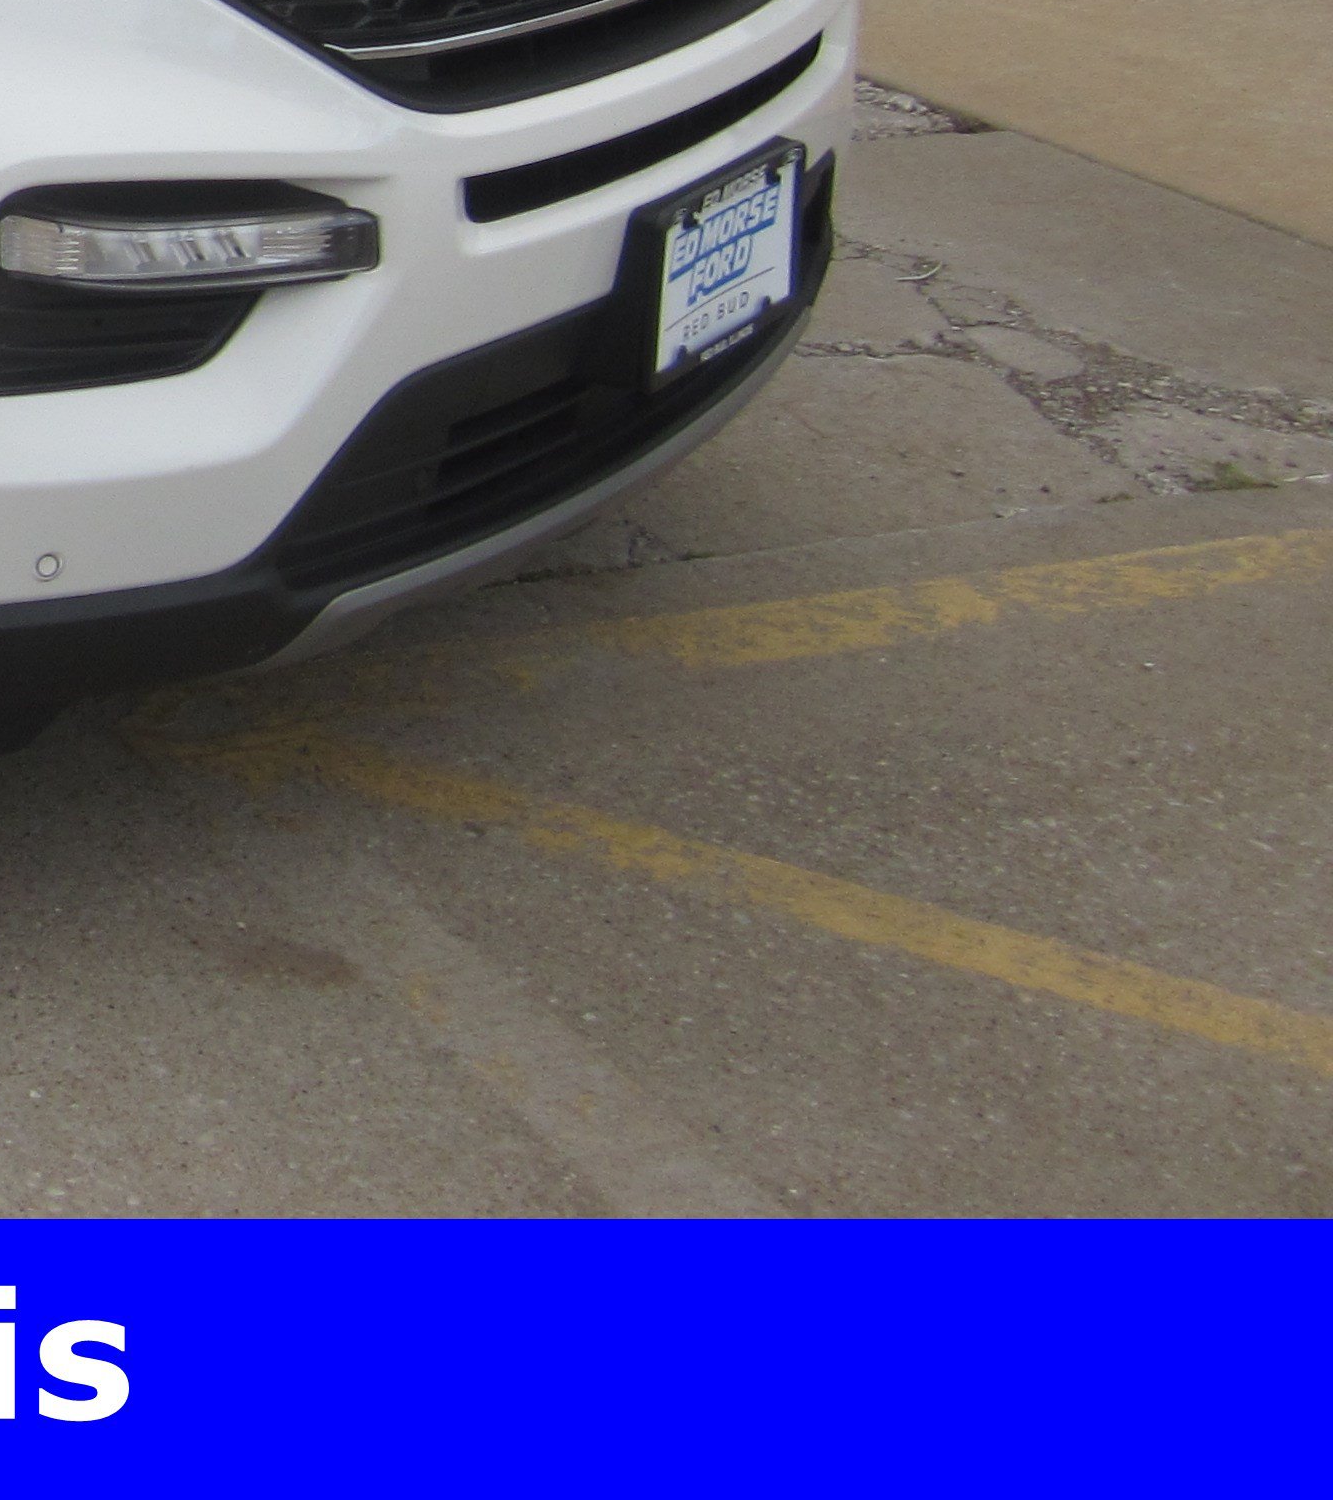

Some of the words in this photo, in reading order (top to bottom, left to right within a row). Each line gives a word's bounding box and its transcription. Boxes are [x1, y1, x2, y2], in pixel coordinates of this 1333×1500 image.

[668, 227, 702, 279] ED
[700, 182, 782, 249] MORSE
[686, 234, 753, 306] FORD
[683, 313, 710, 339] RED
[717, 291, 750, 321] BUD
